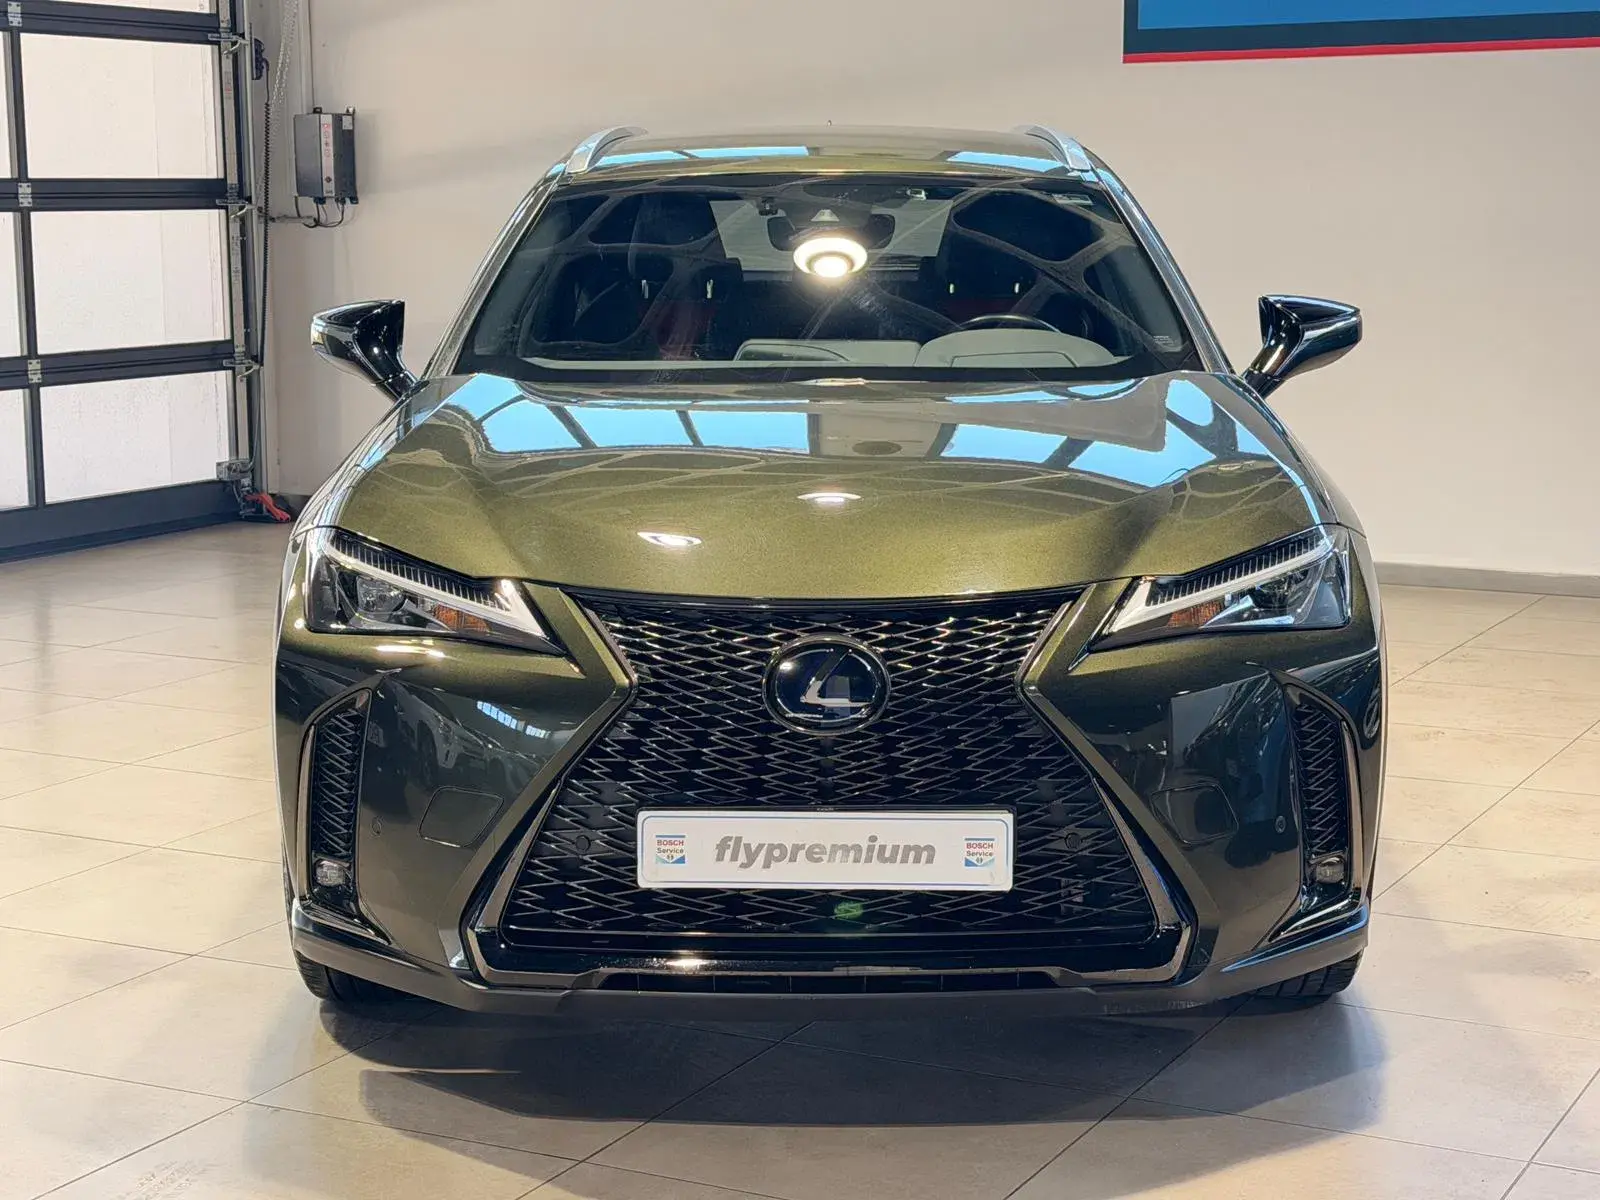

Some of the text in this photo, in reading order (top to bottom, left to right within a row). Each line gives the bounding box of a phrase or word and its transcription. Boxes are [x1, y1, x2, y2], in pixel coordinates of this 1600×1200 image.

[656, 839, 684, 847] BOSCH
[966, 842, 994, 850] BOSCH
[715, 835, 936, 869] flypremium
